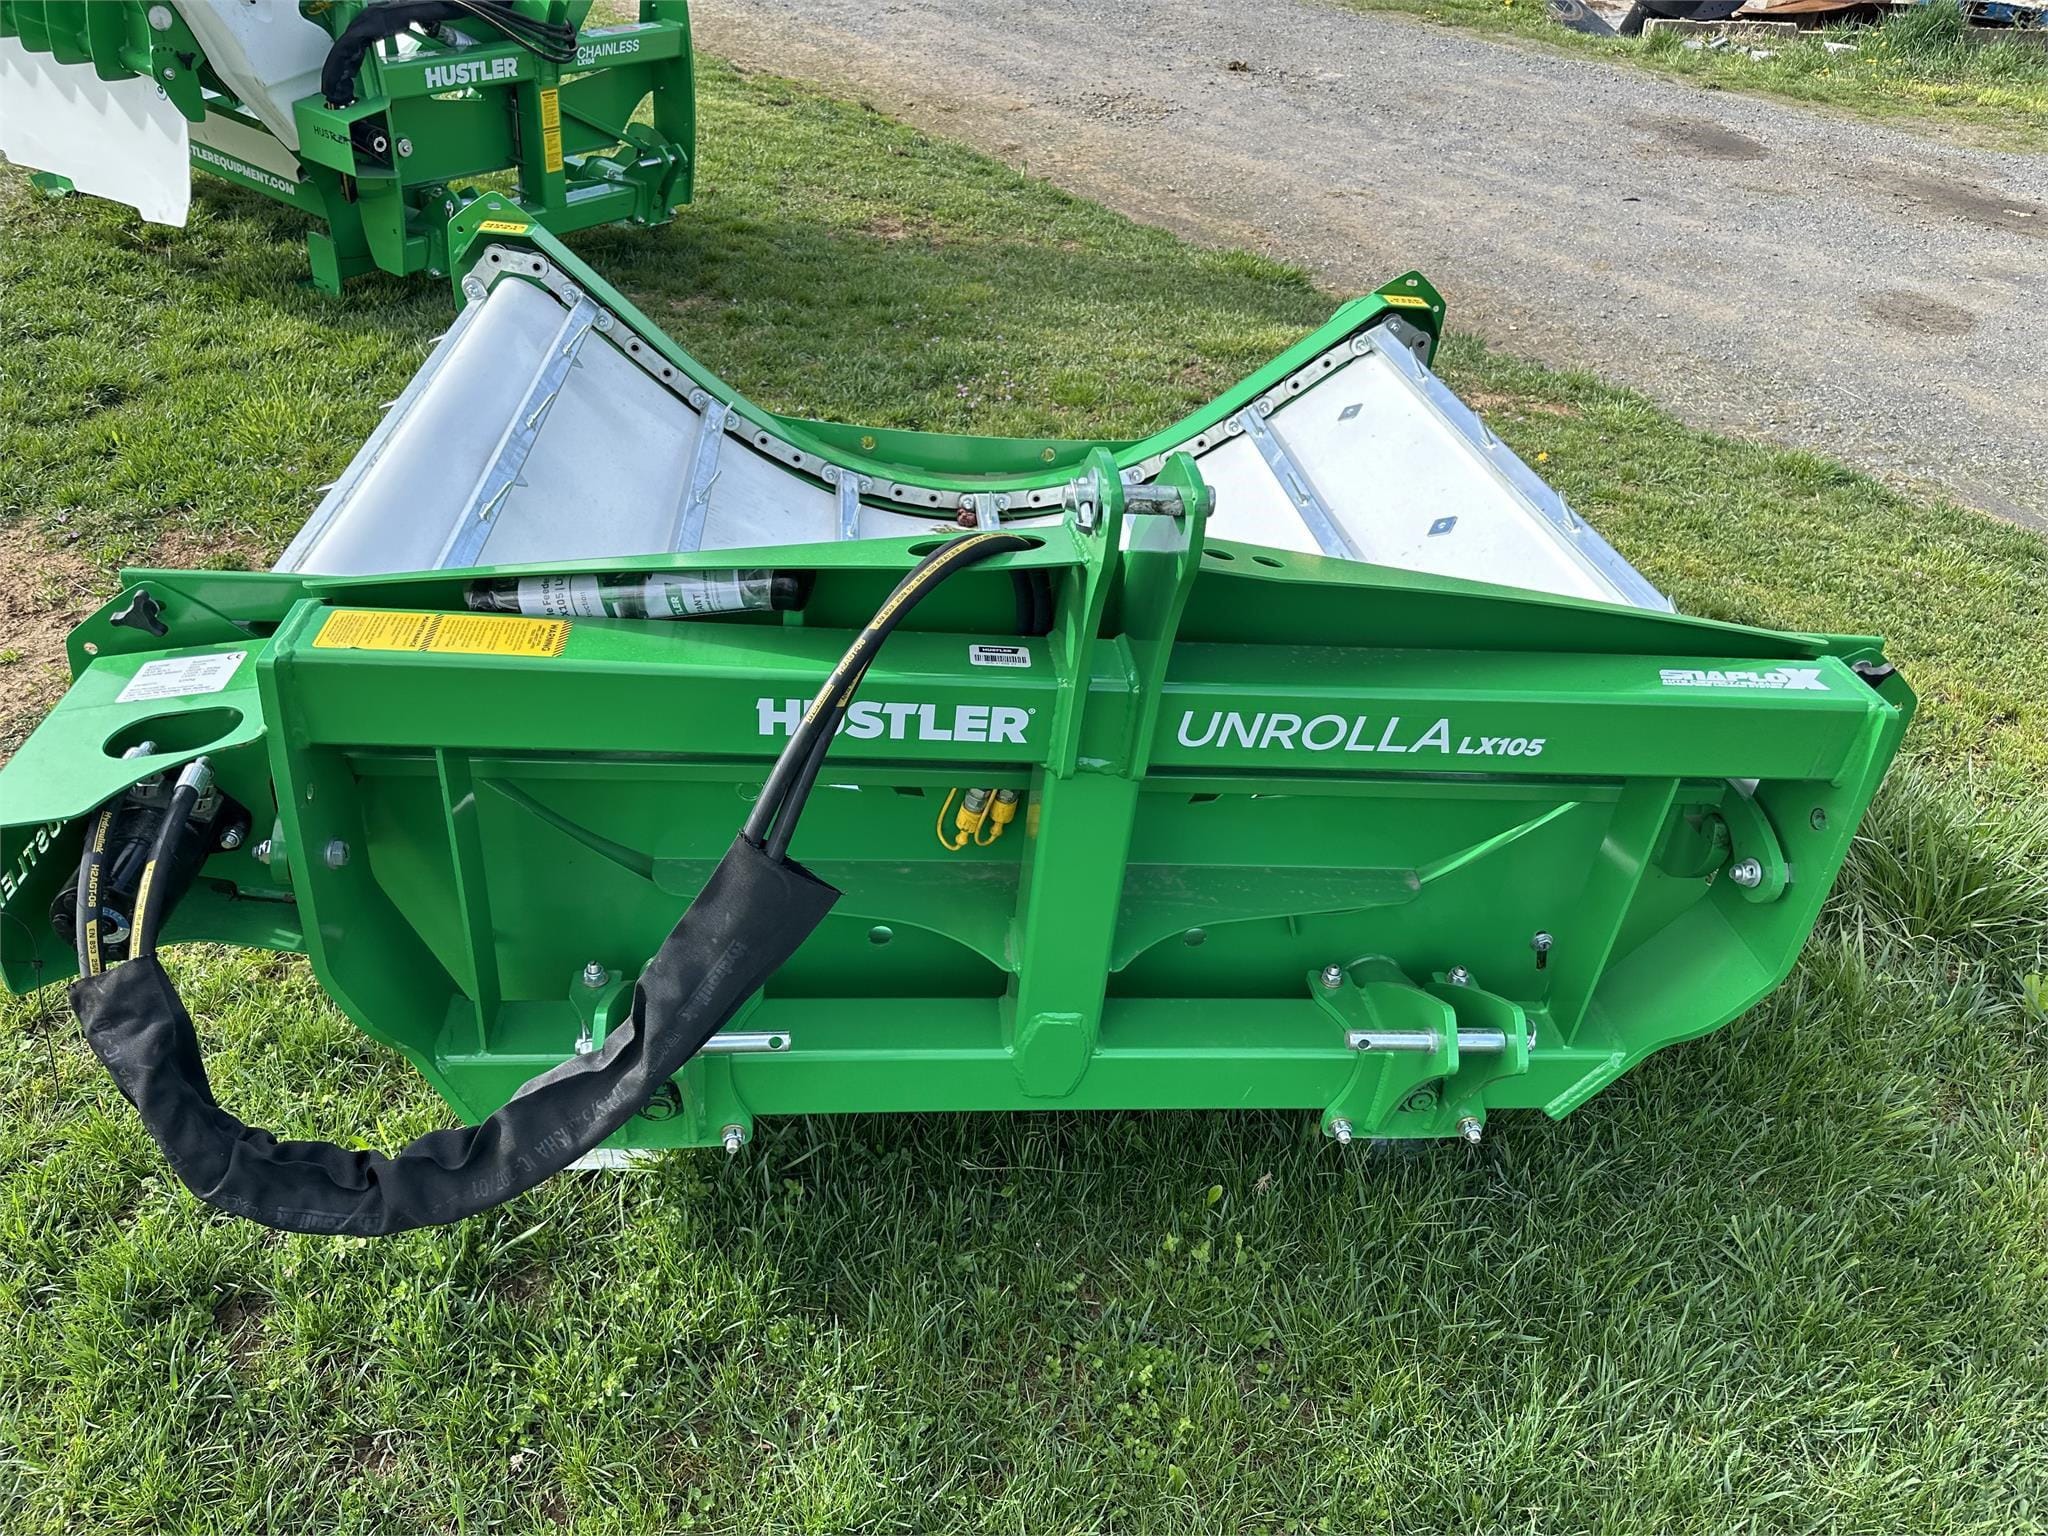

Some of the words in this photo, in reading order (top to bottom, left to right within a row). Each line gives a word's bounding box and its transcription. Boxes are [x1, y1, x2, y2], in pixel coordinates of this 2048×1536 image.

[577, 39, 640, 59] CHAINLESS
[425, 58, 517, 88] HUSTLER
[189, 145, 295, 195] TLEREQUIPMENT.COM
[541, 624, 558, 652] WARNING
[1177, 711, 1450, 754] UNROLLA
[1457, 737, 1546, 756] LX105
[94, 811, 112, 855] Hydraulink
